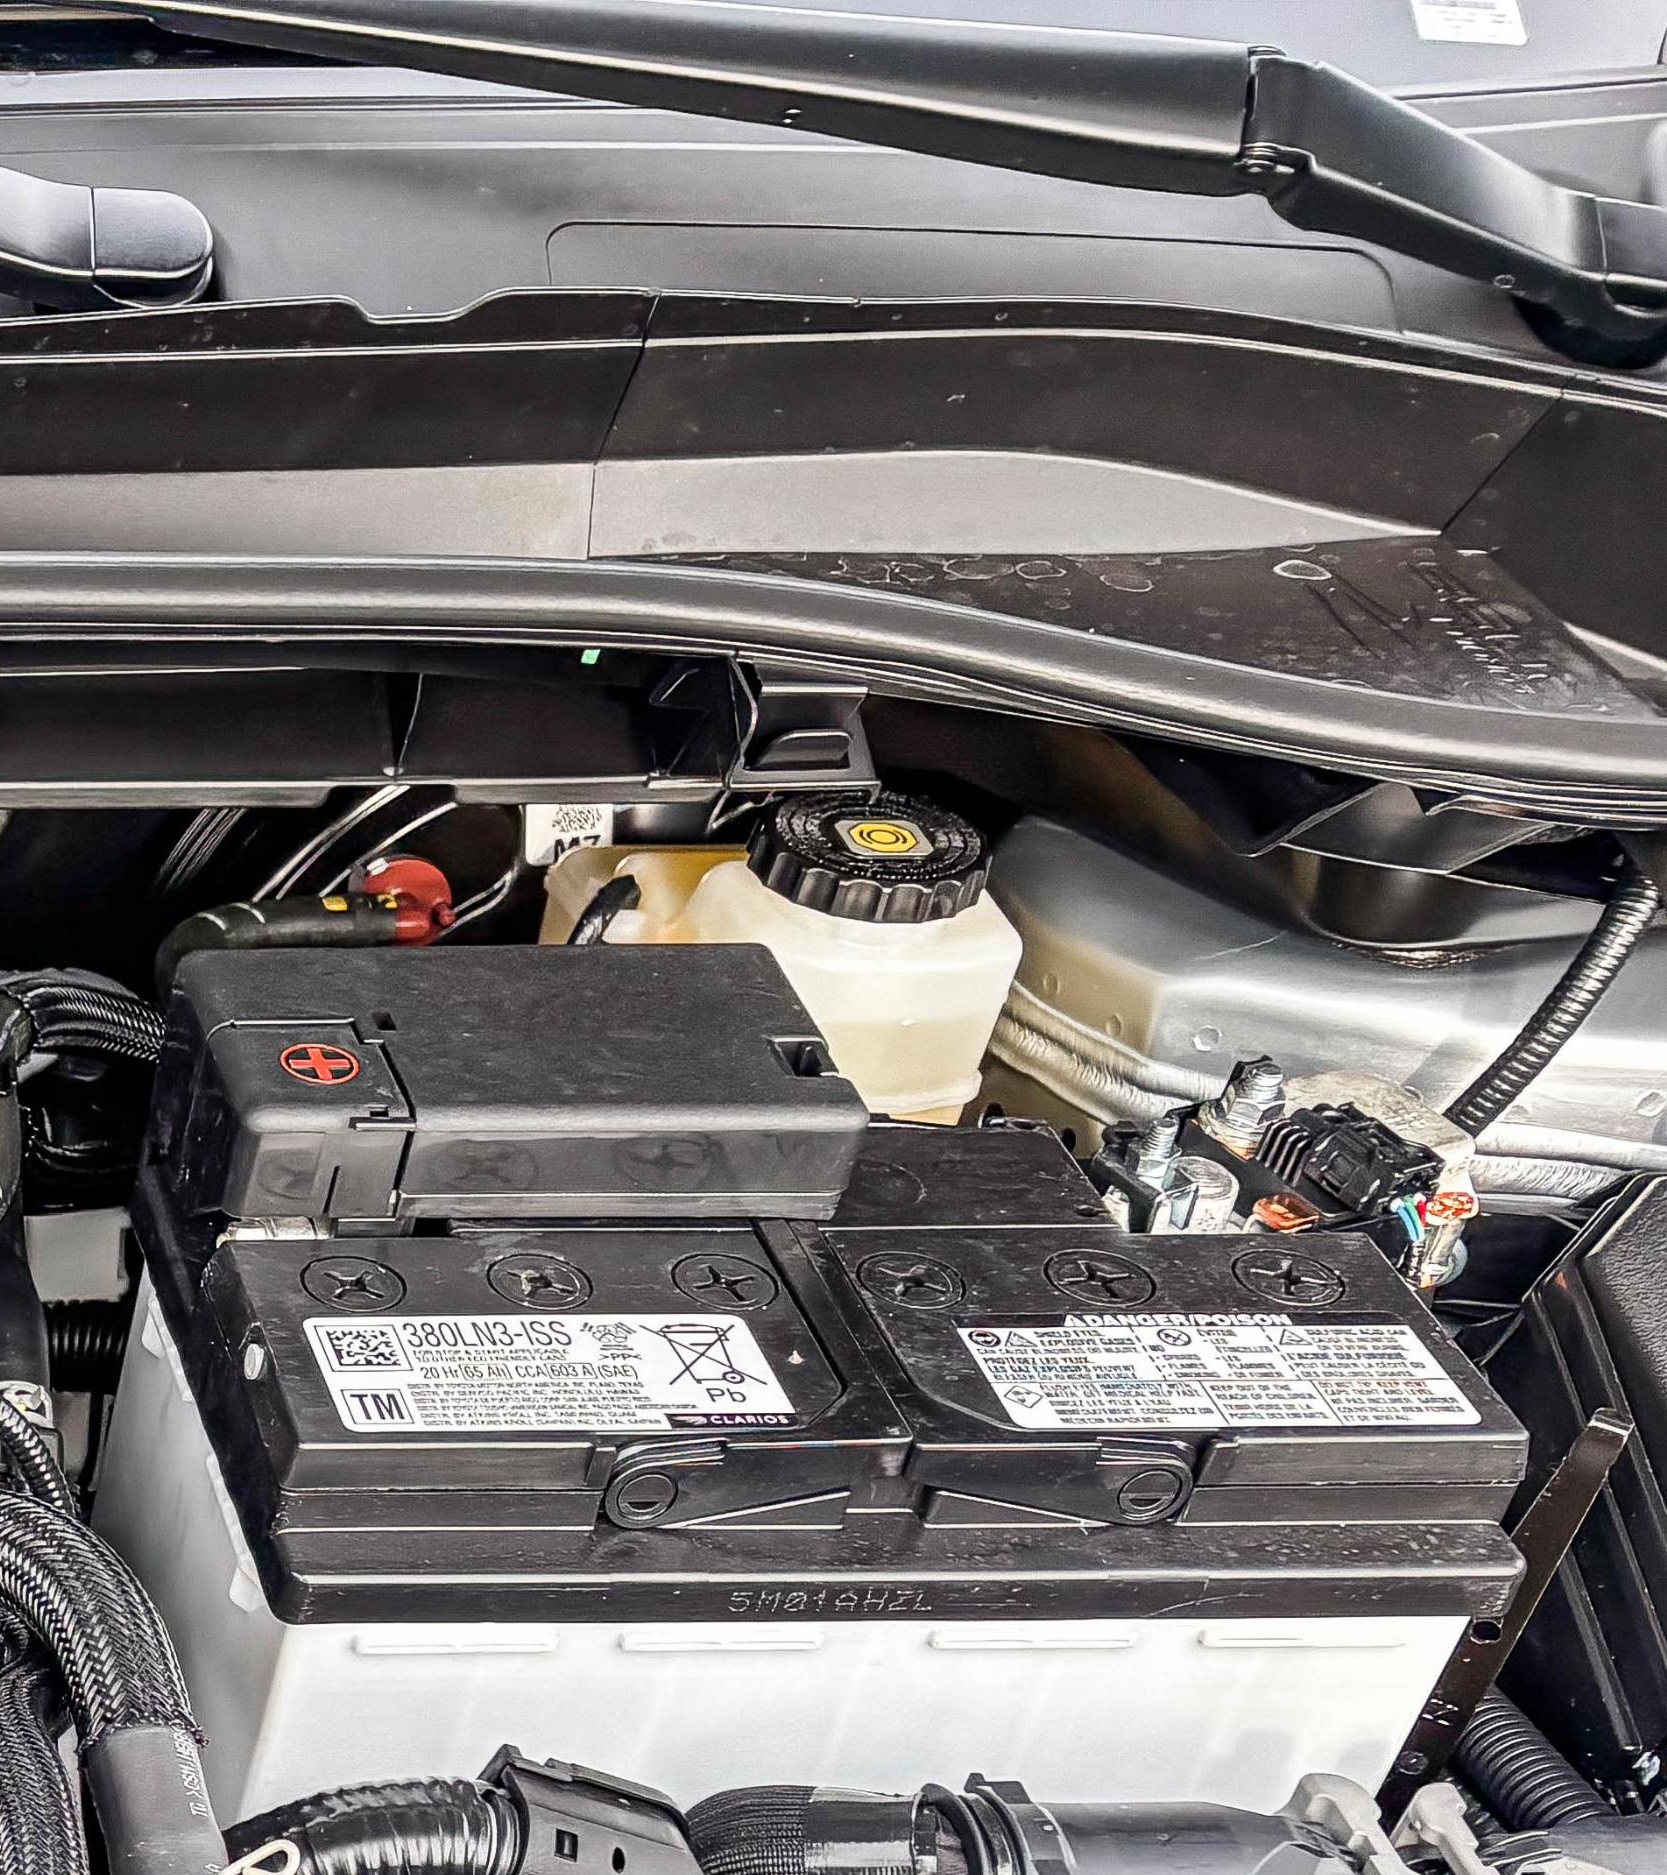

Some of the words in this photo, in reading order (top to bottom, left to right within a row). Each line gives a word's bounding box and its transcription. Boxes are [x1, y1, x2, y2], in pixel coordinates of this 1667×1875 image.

[403, 1320, 572, 1347] 380LN3-ISS
[420, 1366, 440, 1379] 20
[443, 1365, 460, 1379] Hr
[464, 1366, 484, 1379] 65
[515, 1365, 547, 1378] CCA
[550, 1364, 577, 1377] 603
[580, 1364, 594, 1377] A
[597, 1364, 638, 1379] (SAE)
[707, 1387, 747, 1403] Pb
[349, 1394, 409, 1421] TM
[709, 1415, 790, 1426] CLARIOS
